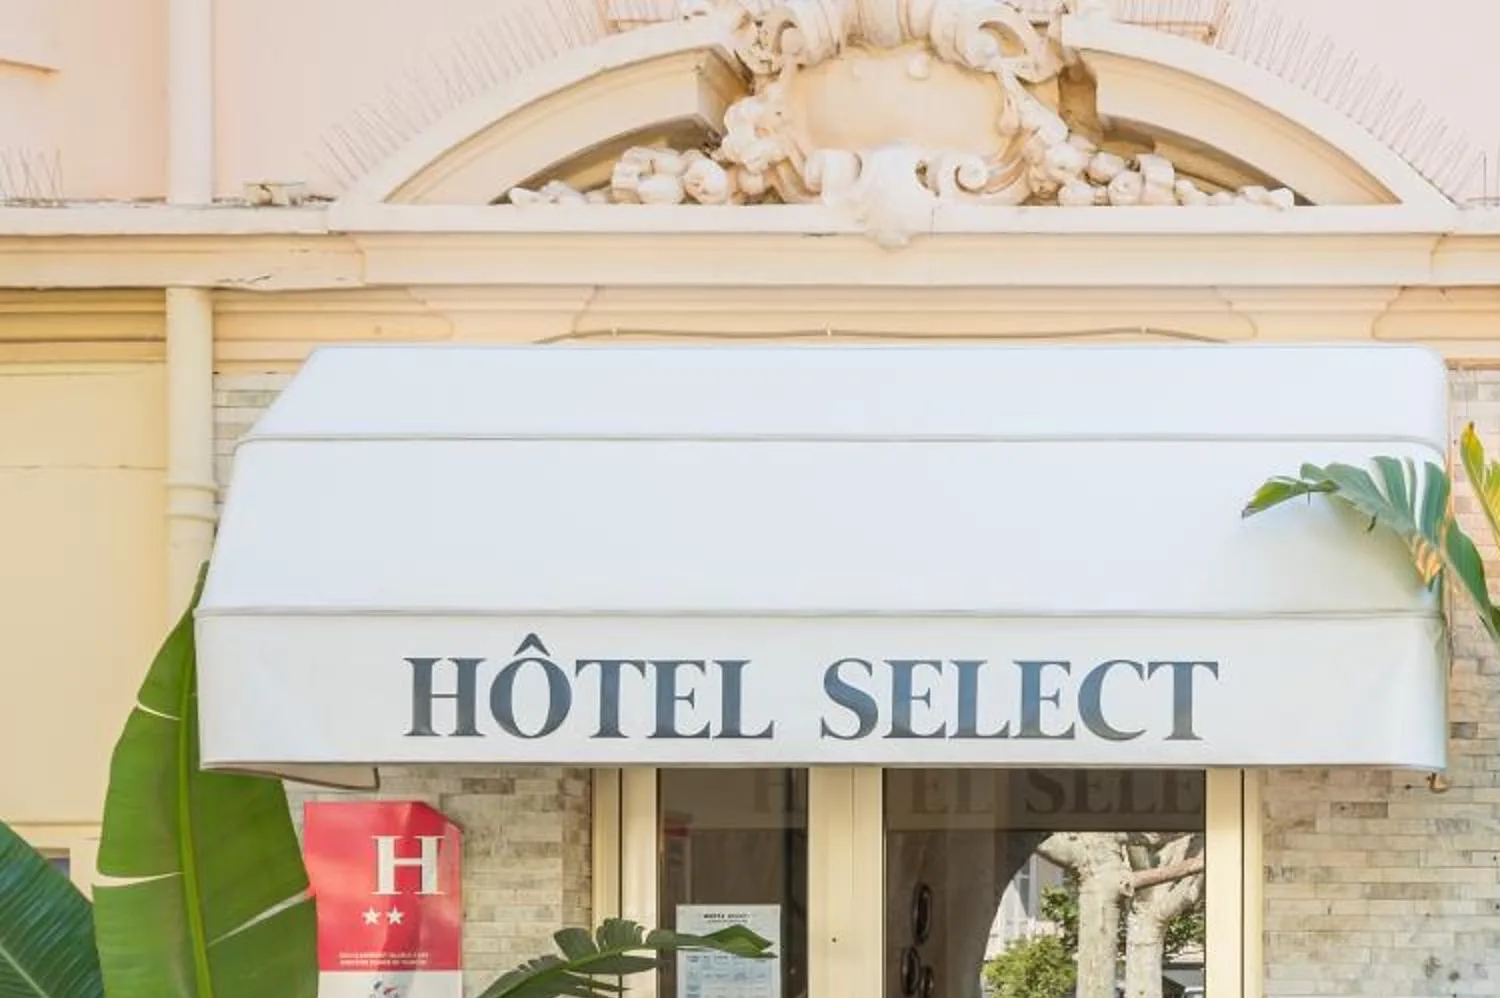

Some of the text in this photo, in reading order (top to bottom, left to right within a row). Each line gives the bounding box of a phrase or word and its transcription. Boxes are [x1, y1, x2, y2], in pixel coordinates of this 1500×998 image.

[404, 632, 1220, 742] HÔTEL SELECT
[371, 835, 447, 895] H
